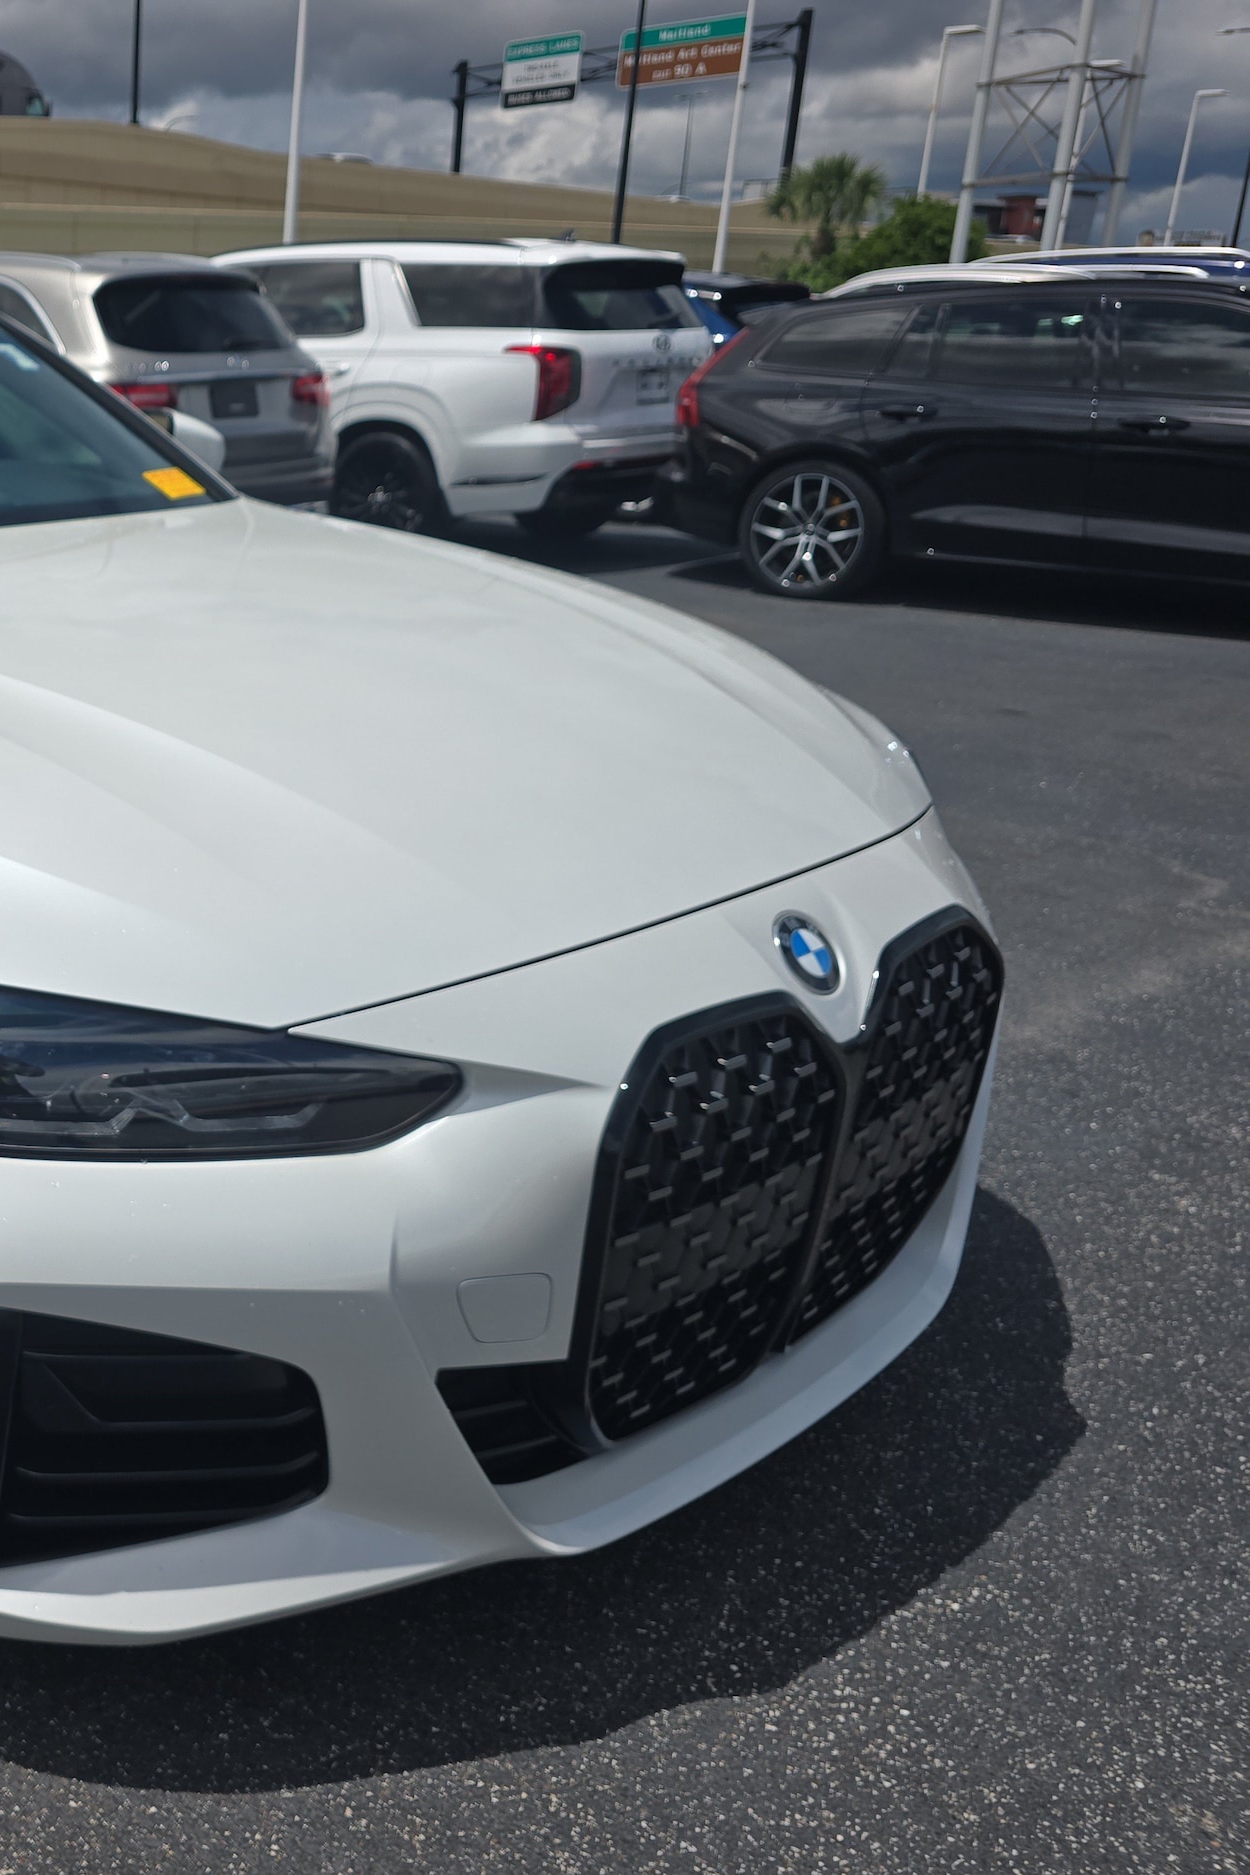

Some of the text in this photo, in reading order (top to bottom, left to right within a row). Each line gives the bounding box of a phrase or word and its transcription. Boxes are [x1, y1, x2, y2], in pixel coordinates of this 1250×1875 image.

[659, 24, 711, 41] Maitland
[549, 38, 579, 52] LANES
[701, 42, 742, 58] Center
